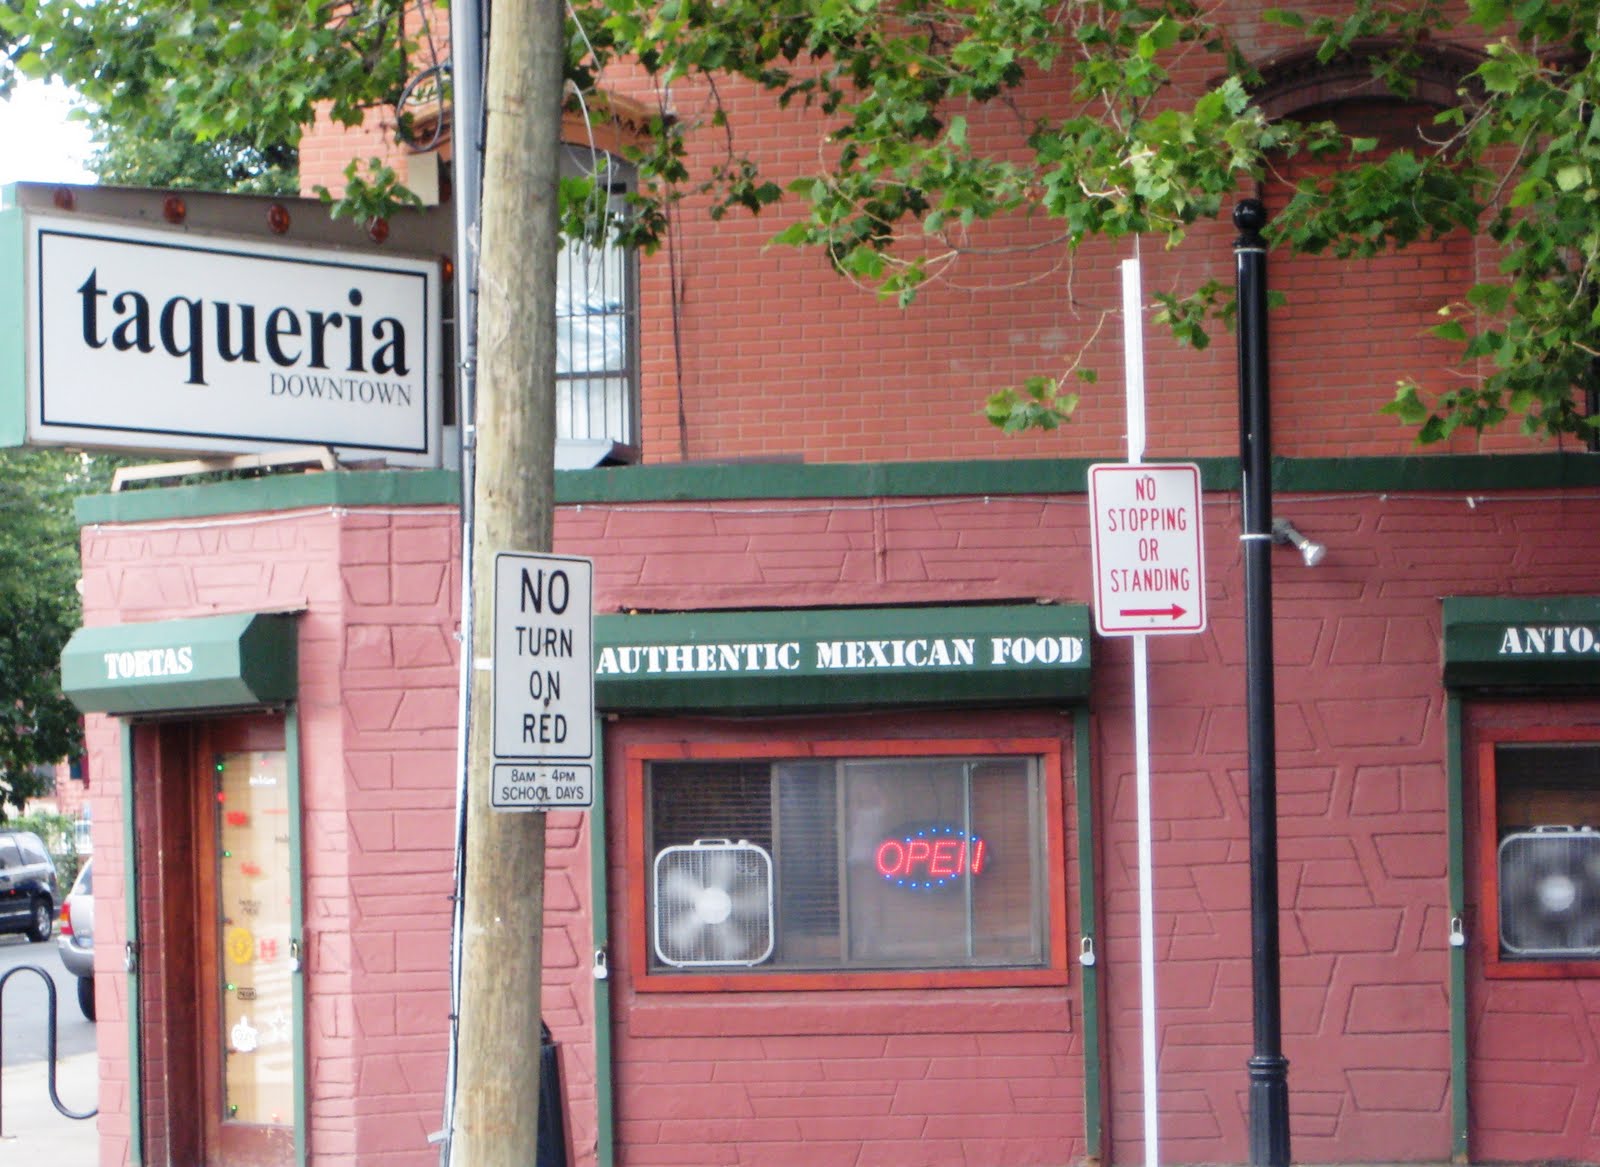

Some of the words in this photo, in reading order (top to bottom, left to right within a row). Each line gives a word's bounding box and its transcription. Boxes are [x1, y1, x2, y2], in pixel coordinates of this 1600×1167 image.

[77, 267, 410, 386] taqueria
[270, 372, 412, 407] DOWNTOWN
[1135, 477, 1156, 501] NO
[1108, 507, 1187, 532] STOPPING
[1138, 538, 1160, 562] OR
[520, 567, 570, 616] NO
[1110, 568, 1190, 593] STANDING
[515, 626, 573, 658] TURN
[595, 642, 801, 674] AUTHENTIC
[815, 638, 976, 669] MEXICAN
[991, 636, 1083, 665] FOOD
[104, 646, 193, 680] TORTAS
[529, 670, 561, 701] ON
[523, 713, 568, 744] RED
[511, 768, 536, 782] 8AM
[551, 768, 576, 782] 4PM
[502, 786, 551, 801] SCHOOL
[556, 786, 584, 800] DAYS
[877, 840, 985, 874] OPEN
